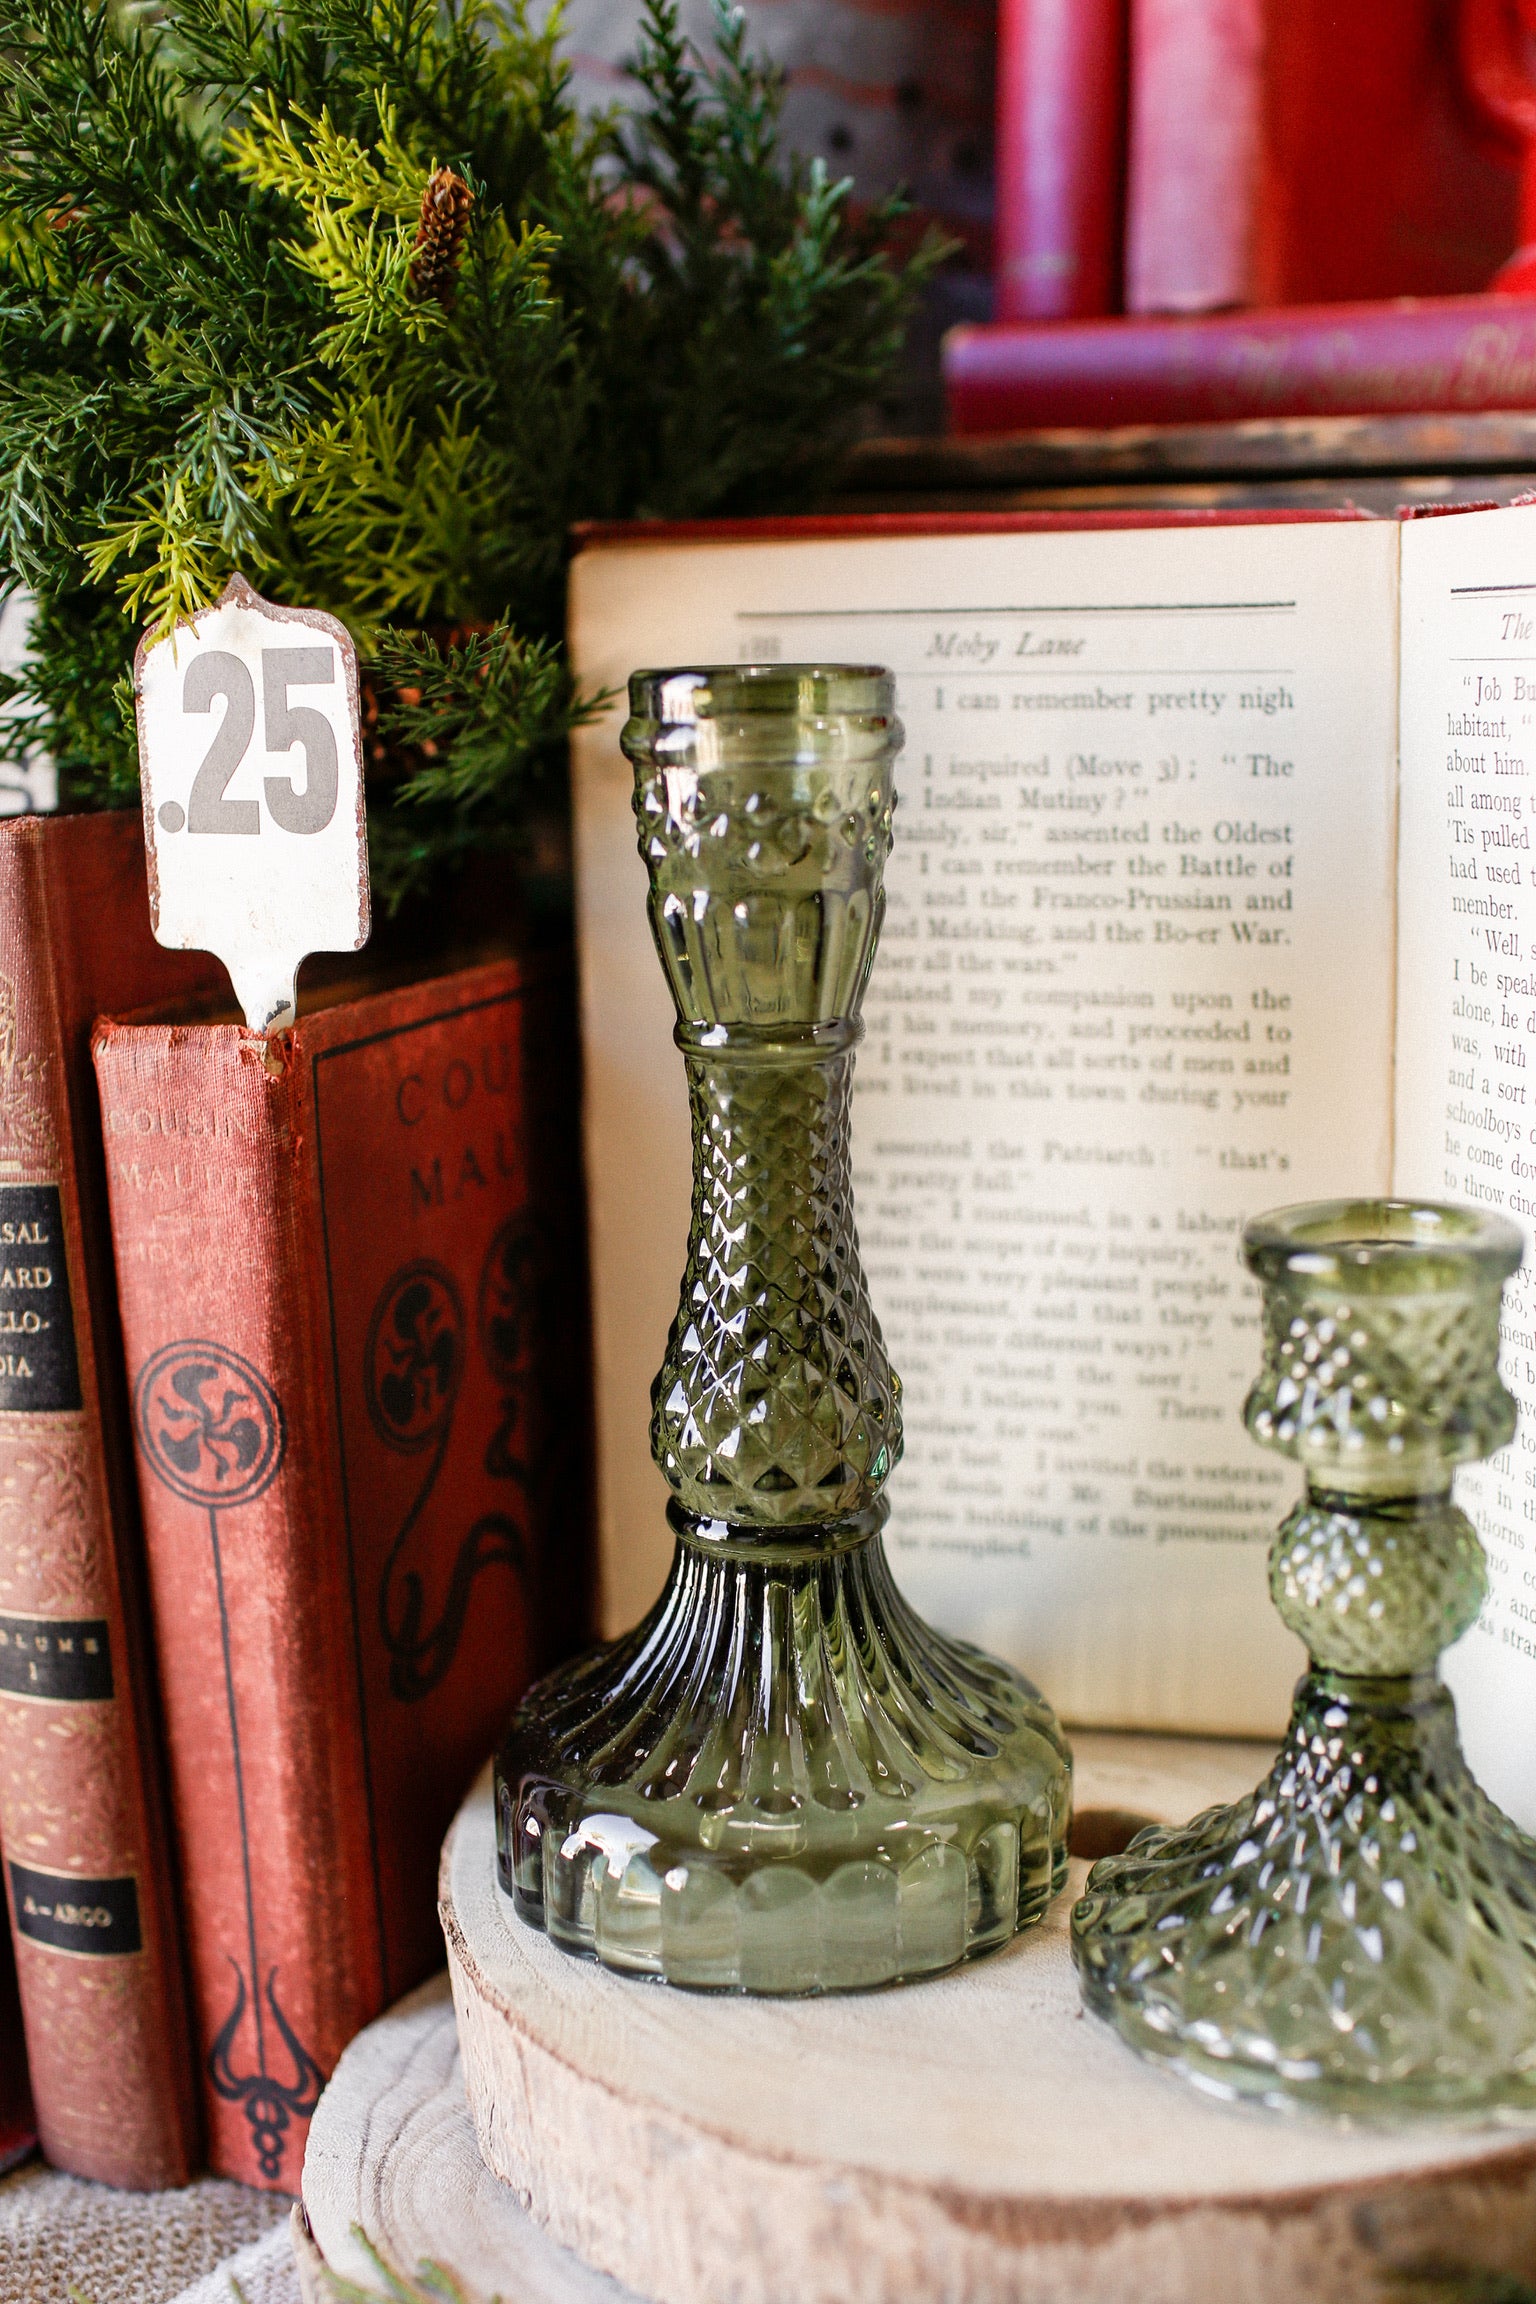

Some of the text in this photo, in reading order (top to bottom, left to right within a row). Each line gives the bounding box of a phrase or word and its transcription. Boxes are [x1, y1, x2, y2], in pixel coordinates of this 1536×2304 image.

[1501, 612, 1534, 641] The
[927, 631, 1086, 663] Moby Lane
[934, 684, 1293, 716] I can remember pretty nigh
[157, 646, 340, 835] .25
[1447, 713, 1512, 742] habitant,
[922, 754, 932, 776] I
[949, 754, 1049, 785] inquired
[1065, 754, 1142, 780] (Move
[1446, 749, 1529, 776] about him.
[924, 788, 1001, 809] Indian
[1447, 785, 1464, 808] all
[1471, 793, 1522, 820] among
[1045, 820, 1149, 844] assented
[1162, 821, 1200, 843] the
[1213, 820, 1293, 844] Oldest
[1481, 824, 1530, 852] pulled
[940, 853, 1293, 877] can remember the Battle of
[1450, 855, 1477, 880] had
[1486, 862, 1521, 885] used
[924, 887, 967, 909] and
[980, 886, 1018, 909] the
[1033, 885, 1231, 911] Franco-Prussian
[1245, 888, 1293, 911] and
[1452, 895, 1518, 920] member.
[1051, 919, 1095, 942] and
[1105, 919, 1144, 943] the
[1231, 921, 1292, 945] War.
[922, 953, 950, 972] all
[959, 953, 993, 973] the
[1453, 958, 1460, 981] I
[1470, 962, 1488, 987] be
[1170, 993, 1232, 1017] upon
[1249, 989, 1292, 1012] the
[1452, 995, 1495, 1027] alone,
[1501, 1004, 1519, 1029] he
[1068, 1018, 1114, 1041] and
[1127, 1020, 1250, 1049] proceeded
[1265, 1024, 1292, 1044] to
[1149, 1051, 1175, 1073] of
[1183, 1055, 1235, 1074] men
[1243, 1052, 1291, 1075] and
[1452, 1033, 1526, 1068] was, with
[1140, 1081, 1221, 1108] during
[1231, 1086, 1291, 1110] your
[1448, 1068, 1527, 1105] and a sort
[1446, 1101, 1521, 1144] schoolboys
[1445, 1130, 1460, 1157] he
[1467, 1144, 1503, 1171] come
[1444, 1168, 1457, 1188] to
[1465, 1173, 1504, 1204] throw
[0, 1221, 48, 1245] SAL
[0, 1267, 52, 1289] ARD
[1505, 1357, 1519, 1378] of
[1497, 1484, 1512, 1510] in
[1476, 1509, 1526, 1550] thorns
